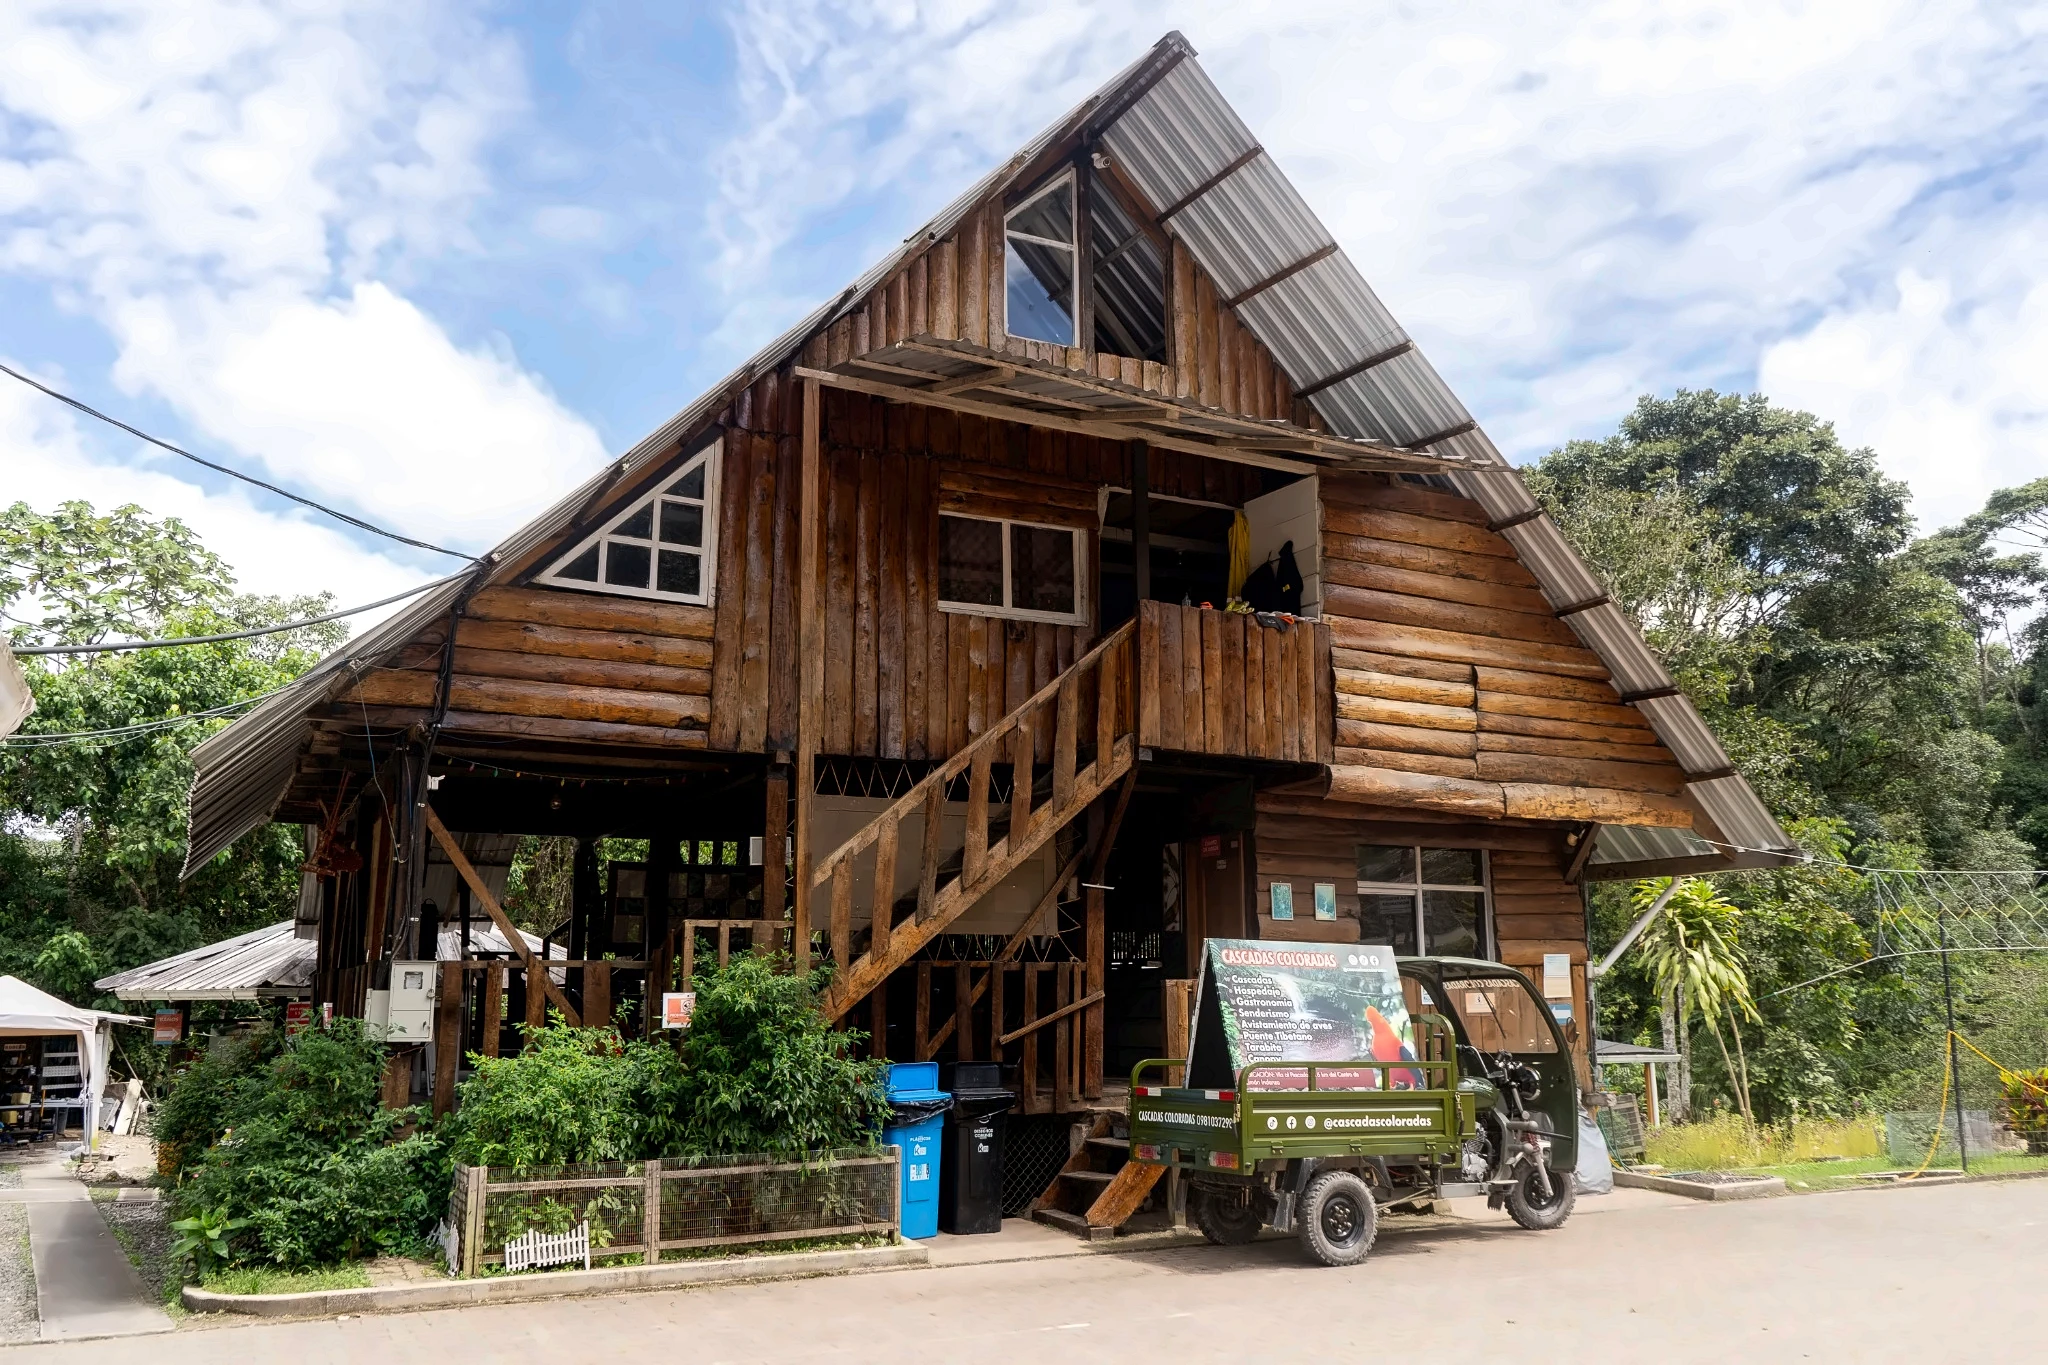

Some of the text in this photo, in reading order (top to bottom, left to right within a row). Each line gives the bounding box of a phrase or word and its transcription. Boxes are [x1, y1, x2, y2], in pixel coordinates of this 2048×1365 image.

[1222, 950, 1337, 967] CASCADAS COLORADAS
[1232, 974, 1273, 984] Cascadas
[1233, 986, 1281, 997] Hospedaje
[1238, 1008, 1290, 1018] Senderismo
[1241, 1020, 1333, 1030] Avistamiento de aves
[1243, 1031, 1313, 1041] Puente Tibetano
[1245, 1042, 1283, 1052] Tarabita
[1138, 1111, 1164, 1122] CASCADAS
[1164, 1112, 1196, 1125] COLORADAS
[1323, 1114, 1432, 1130] @cascadascoloradas
